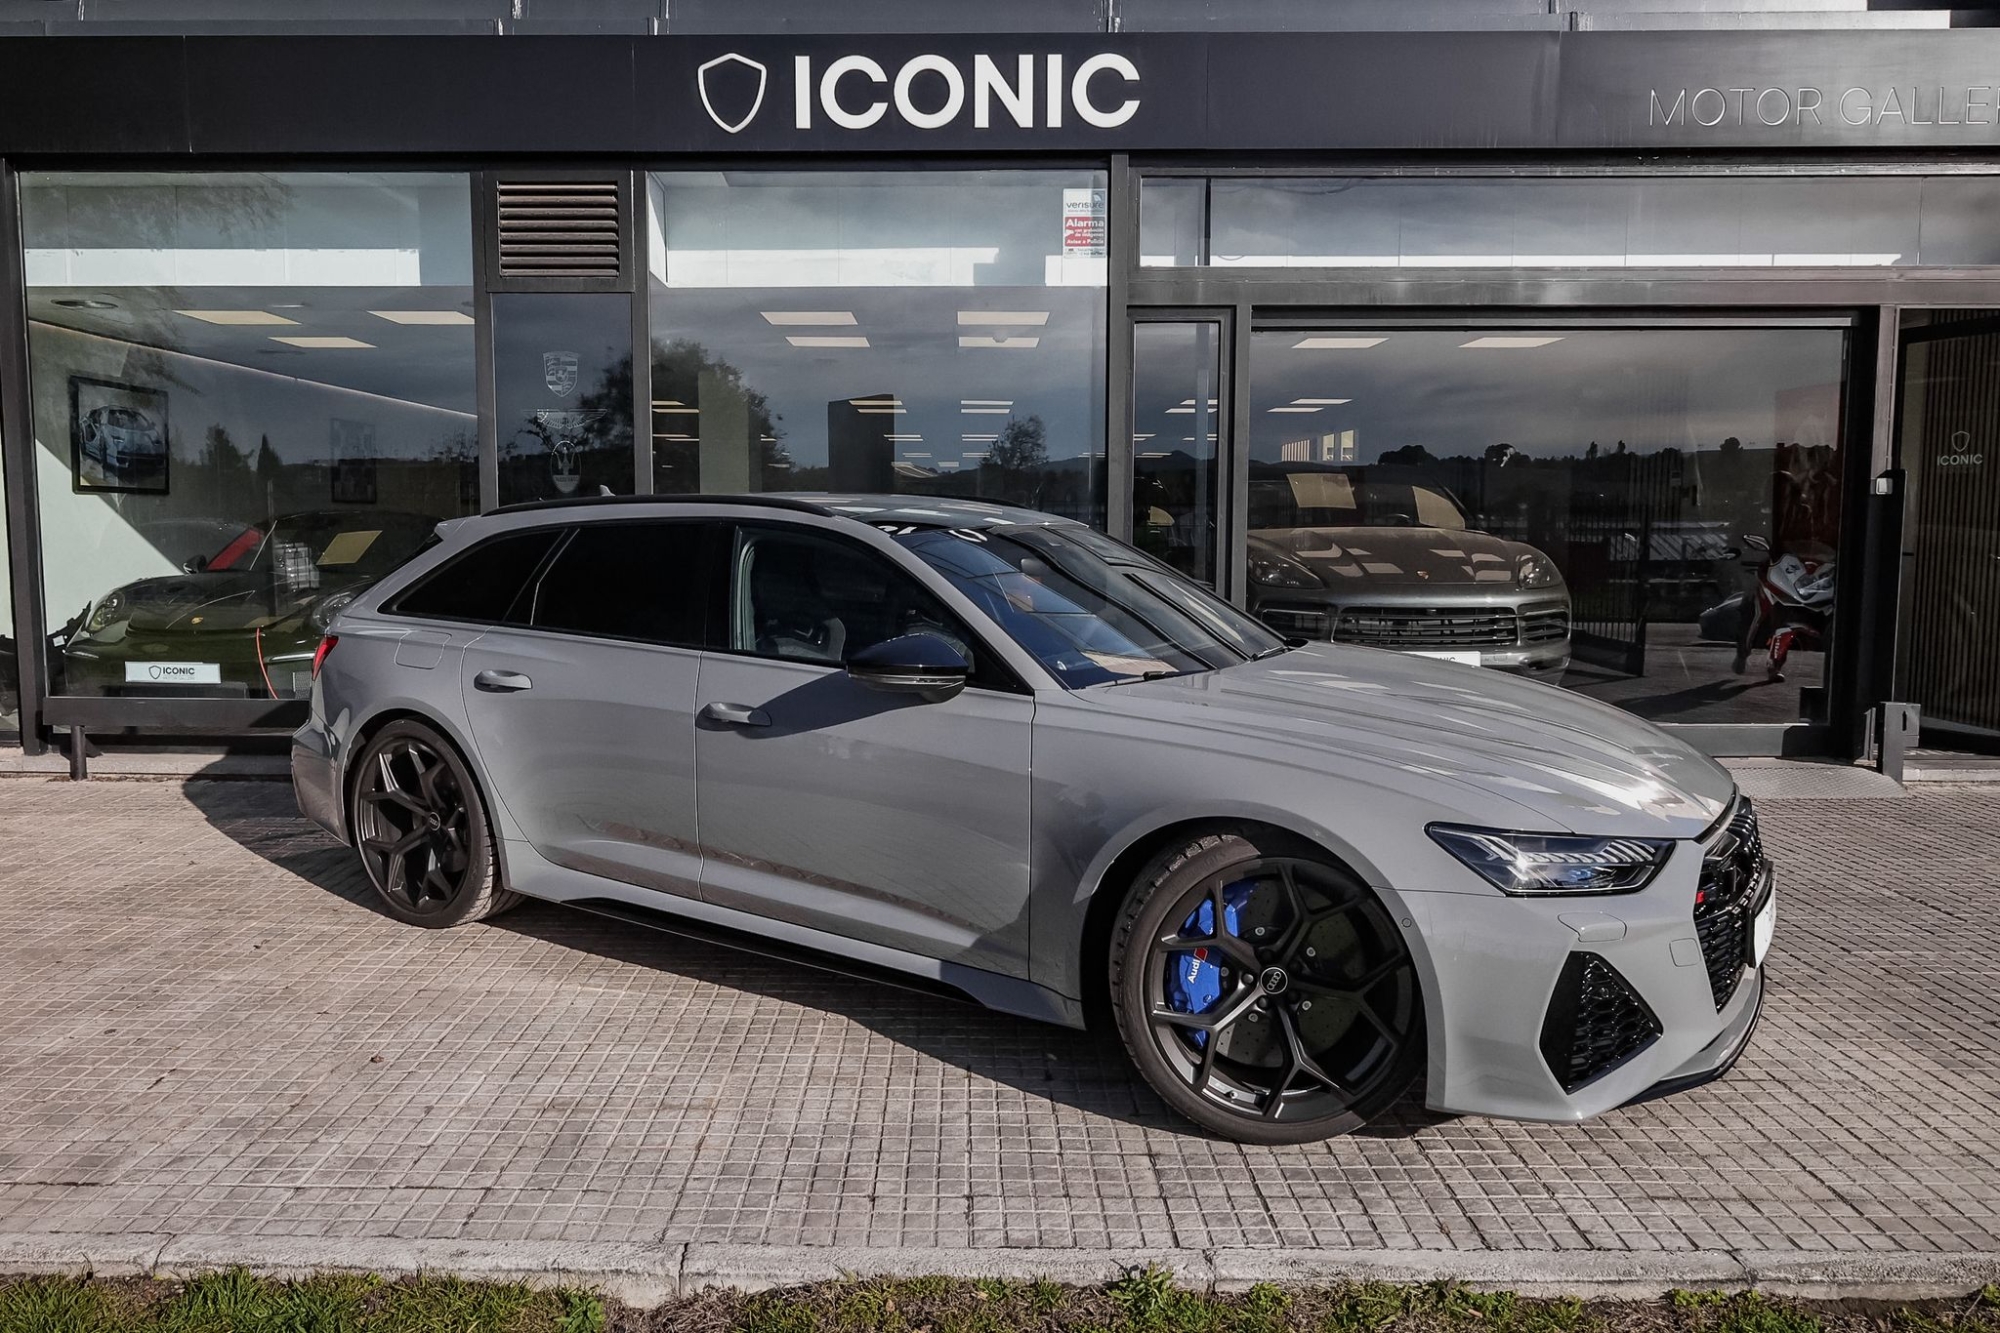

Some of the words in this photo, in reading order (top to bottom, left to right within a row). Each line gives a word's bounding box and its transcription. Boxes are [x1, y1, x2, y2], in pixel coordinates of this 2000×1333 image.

[795, 53, 1141, 129] ICONIC
[1649, 87, 1823, 126] MOTOR
[1839, 86, 2000, 125] GALLE
[1066, 201, 1104, 209] verisure
[1066, 218, 1104, 227] Alarma
[1937, 453, 1983, 466] ICONIC
[163, 666, 195, 675] ICONIC
[1187, 958, 1201, 984] Audi
